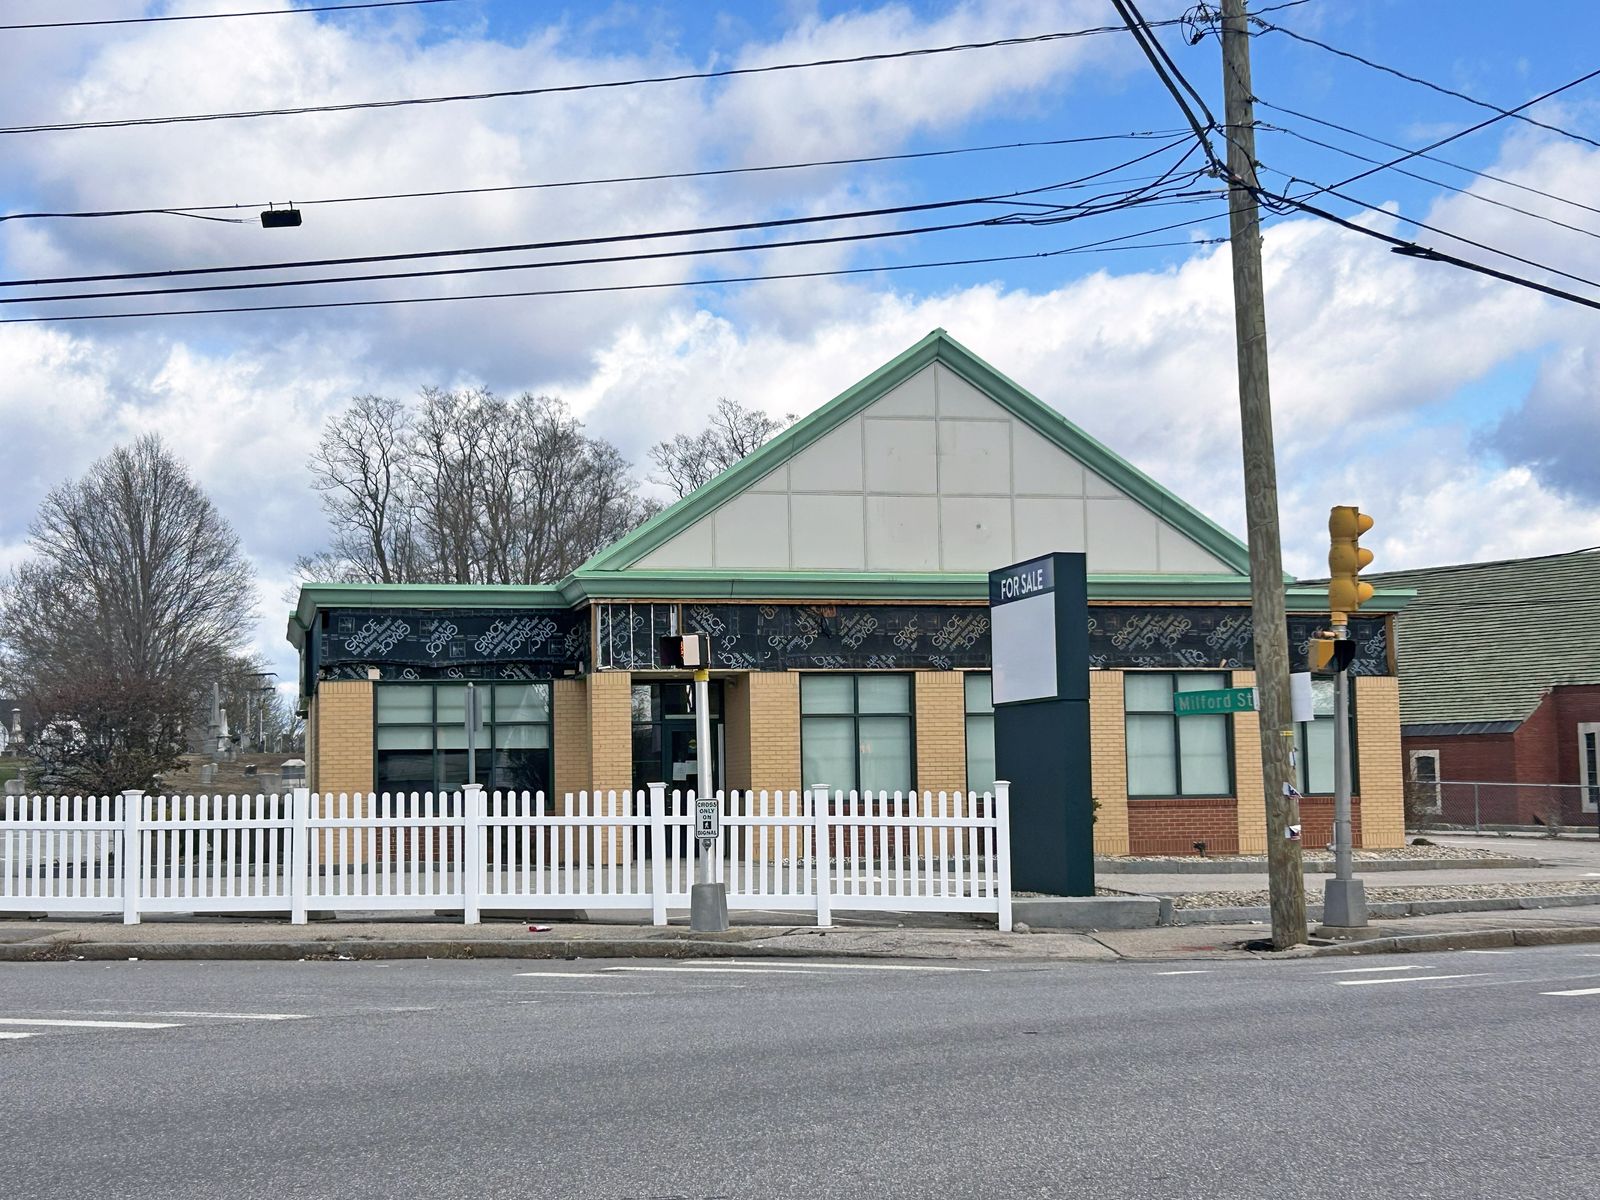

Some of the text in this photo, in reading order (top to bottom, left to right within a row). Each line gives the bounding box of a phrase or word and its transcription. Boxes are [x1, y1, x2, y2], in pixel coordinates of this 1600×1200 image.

[1001, 569, 1043, 599] FOR SALE
[344, 618, 380, 651] GRACE
[377, 623, 411, 656] GRACE
[474, 618, 507, 652] GRACE
[505, 621, 532, 655] RACE
[531, 621, 558, 652] GRAC
[847, 617, 878, 650] GRACE
[931, 614, 962, 647] GRACE
[962, 617, 990, 651] GRACE
[1364, 625, 1386, 654] GRAC
[1179, 692, 1253, 711] Milford St
